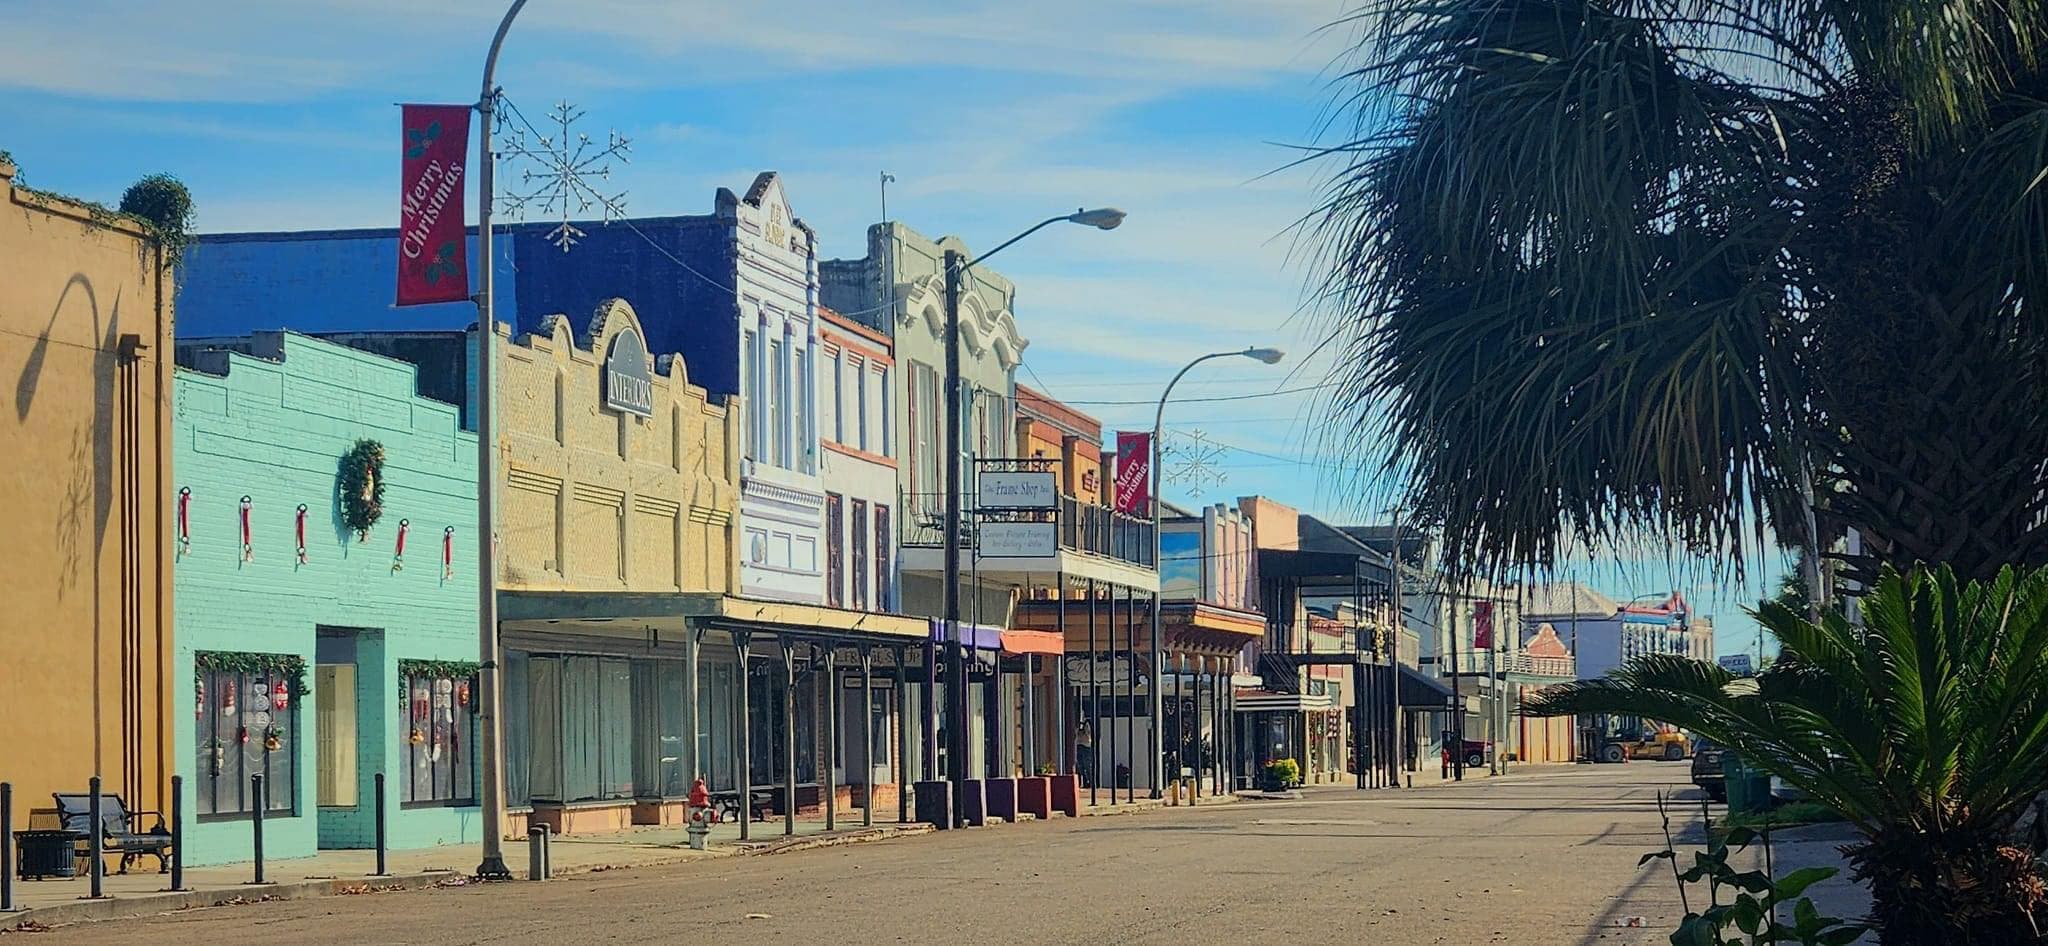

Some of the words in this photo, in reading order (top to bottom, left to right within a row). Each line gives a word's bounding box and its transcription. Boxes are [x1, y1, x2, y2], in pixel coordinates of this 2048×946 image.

[403, 160, 443, 221] Merry
[403, 162, 463, 259] Christmas
[610, 370, 651, 409] INTERIORS
[1020, 481, 1038, 499] Shop
[1116, 459, 1139, 490] Merry
[1118, 461, 1149, 508] Christmas
